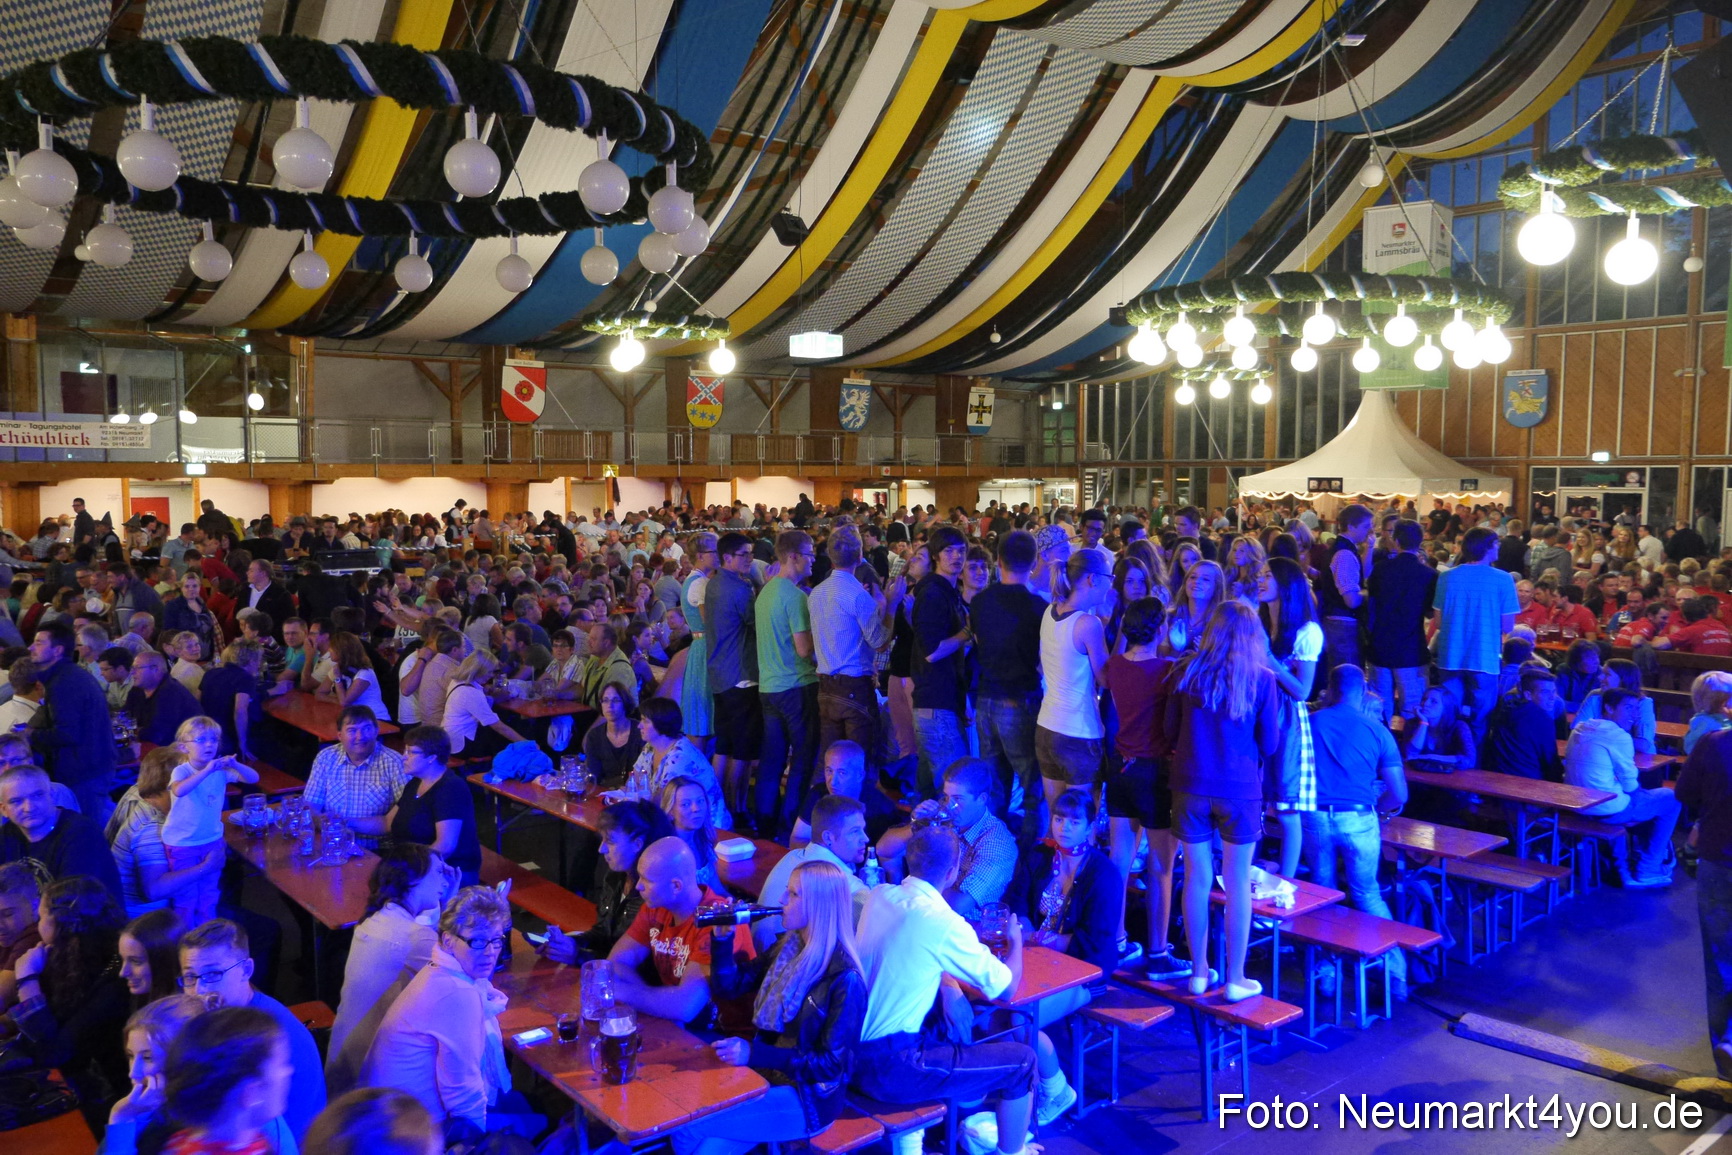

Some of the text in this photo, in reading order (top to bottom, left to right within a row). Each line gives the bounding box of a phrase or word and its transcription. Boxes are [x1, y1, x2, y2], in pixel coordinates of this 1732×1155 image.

[1382, 240, 1415, 248] Neumarkter
[1375, 245, 1420, 257] Lammsbräu
[29, 422, 82, 431] Tagungshotel
[1309, 480, 1341, 490] BAR
